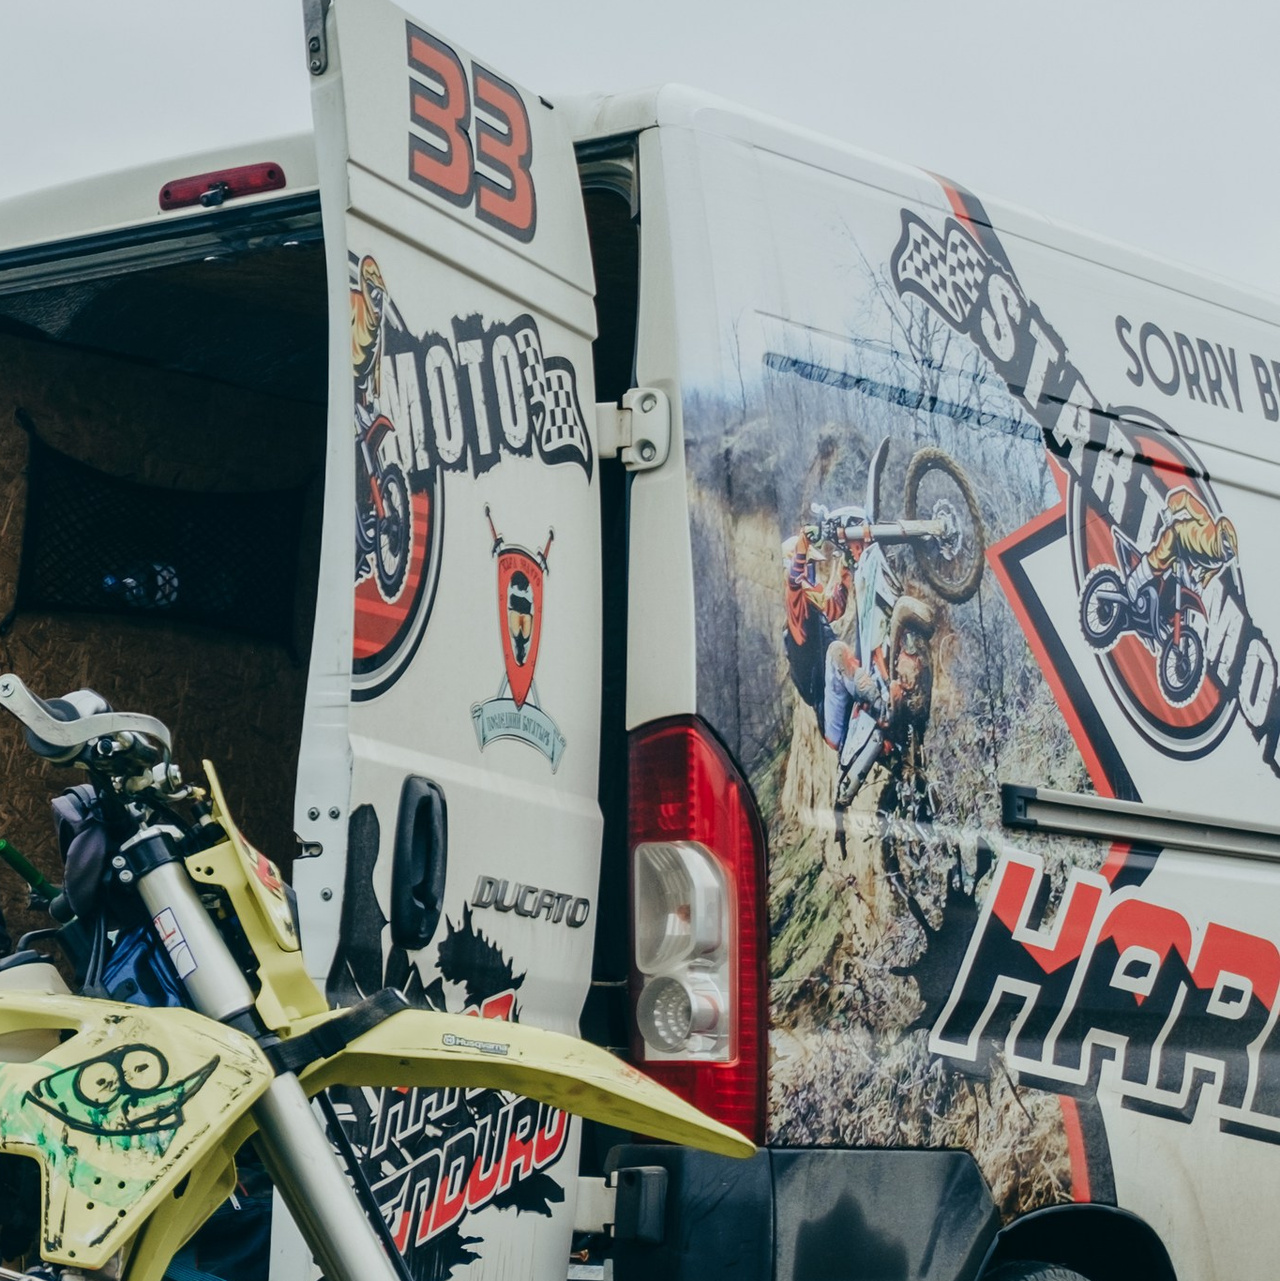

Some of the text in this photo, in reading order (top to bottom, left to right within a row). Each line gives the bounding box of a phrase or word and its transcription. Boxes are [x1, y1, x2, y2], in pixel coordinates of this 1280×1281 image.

[405, 19, 537, 244] 33
[377, 334, 530, 471] MOTO
[980, 273, 1171, 551] START
[1114, 314, 1244, 414] SORRY
[471, 874, 590, 928] DUCATO
[455, 1037, 508, 1051] Husqvarna
